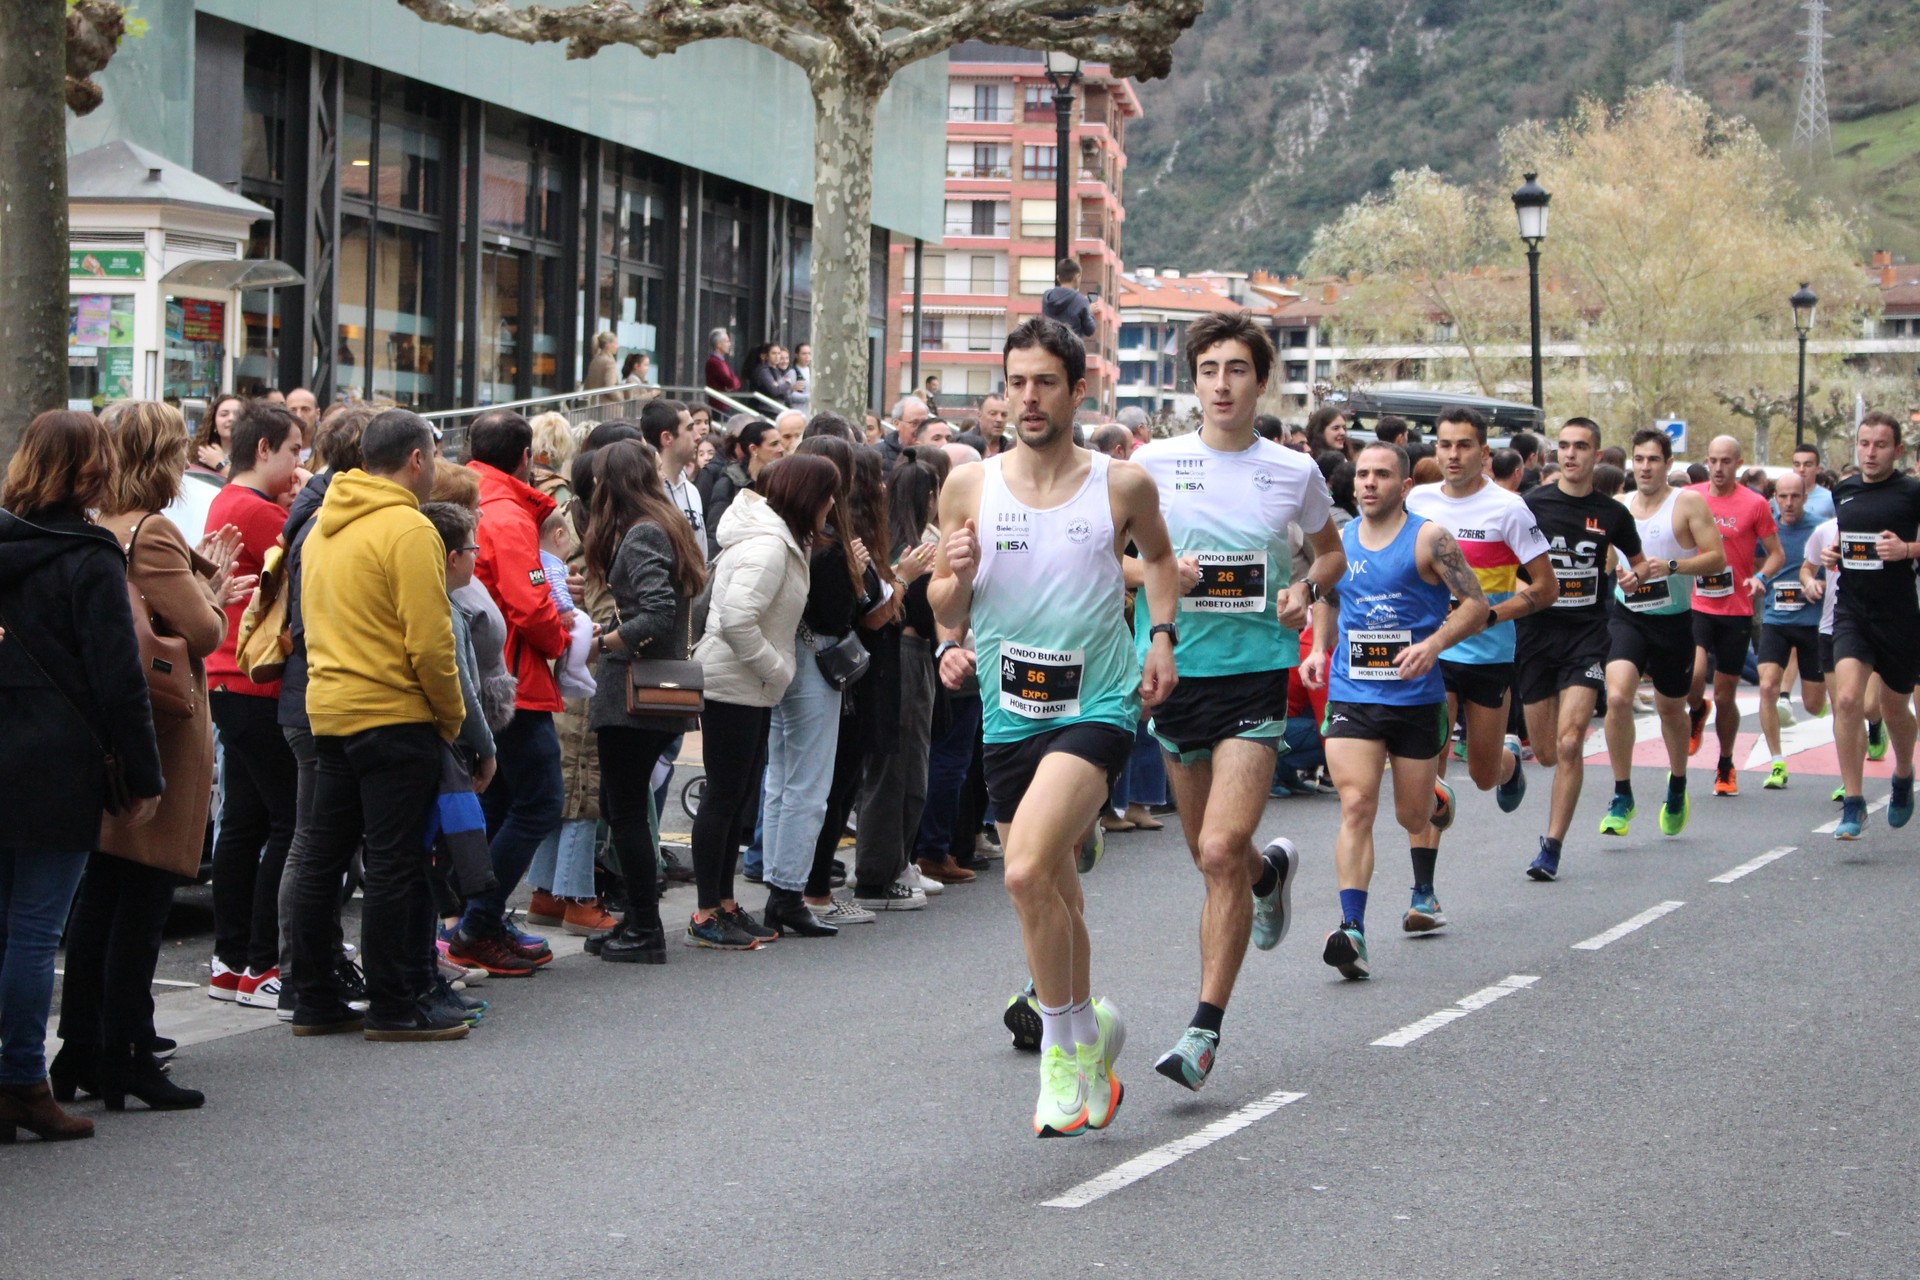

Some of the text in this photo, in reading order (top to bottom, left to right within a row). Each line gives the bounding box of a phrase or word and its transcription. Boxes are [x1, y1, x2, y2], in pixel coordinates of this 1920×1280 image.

[998, 513, 1027, 522] GOBIK
[1458, 528, 1486, 539] 226ERS
[996, 541, 1028, 550] INISA
[1198, 554, 1254, 562] ONDO BUKAU
[1217, 571, 1235, 582] 26
[1208, 588, 1243, 596] HARITZ
[1195, 600, 1254, 608] HOBETO HASI!
[1352, 643, 1363, 653] AS
[1368, 647, 1388, 656] 313
[1010, 647, 1072, 662] ONDO BUKAU
[1003, 659, 1015, 674] AS
[1027, 670, 1046, 684] 56
[1022, 689, 1049, 700] EXPO
[1010, 699, 1067, 714] HOBETO HASI!
